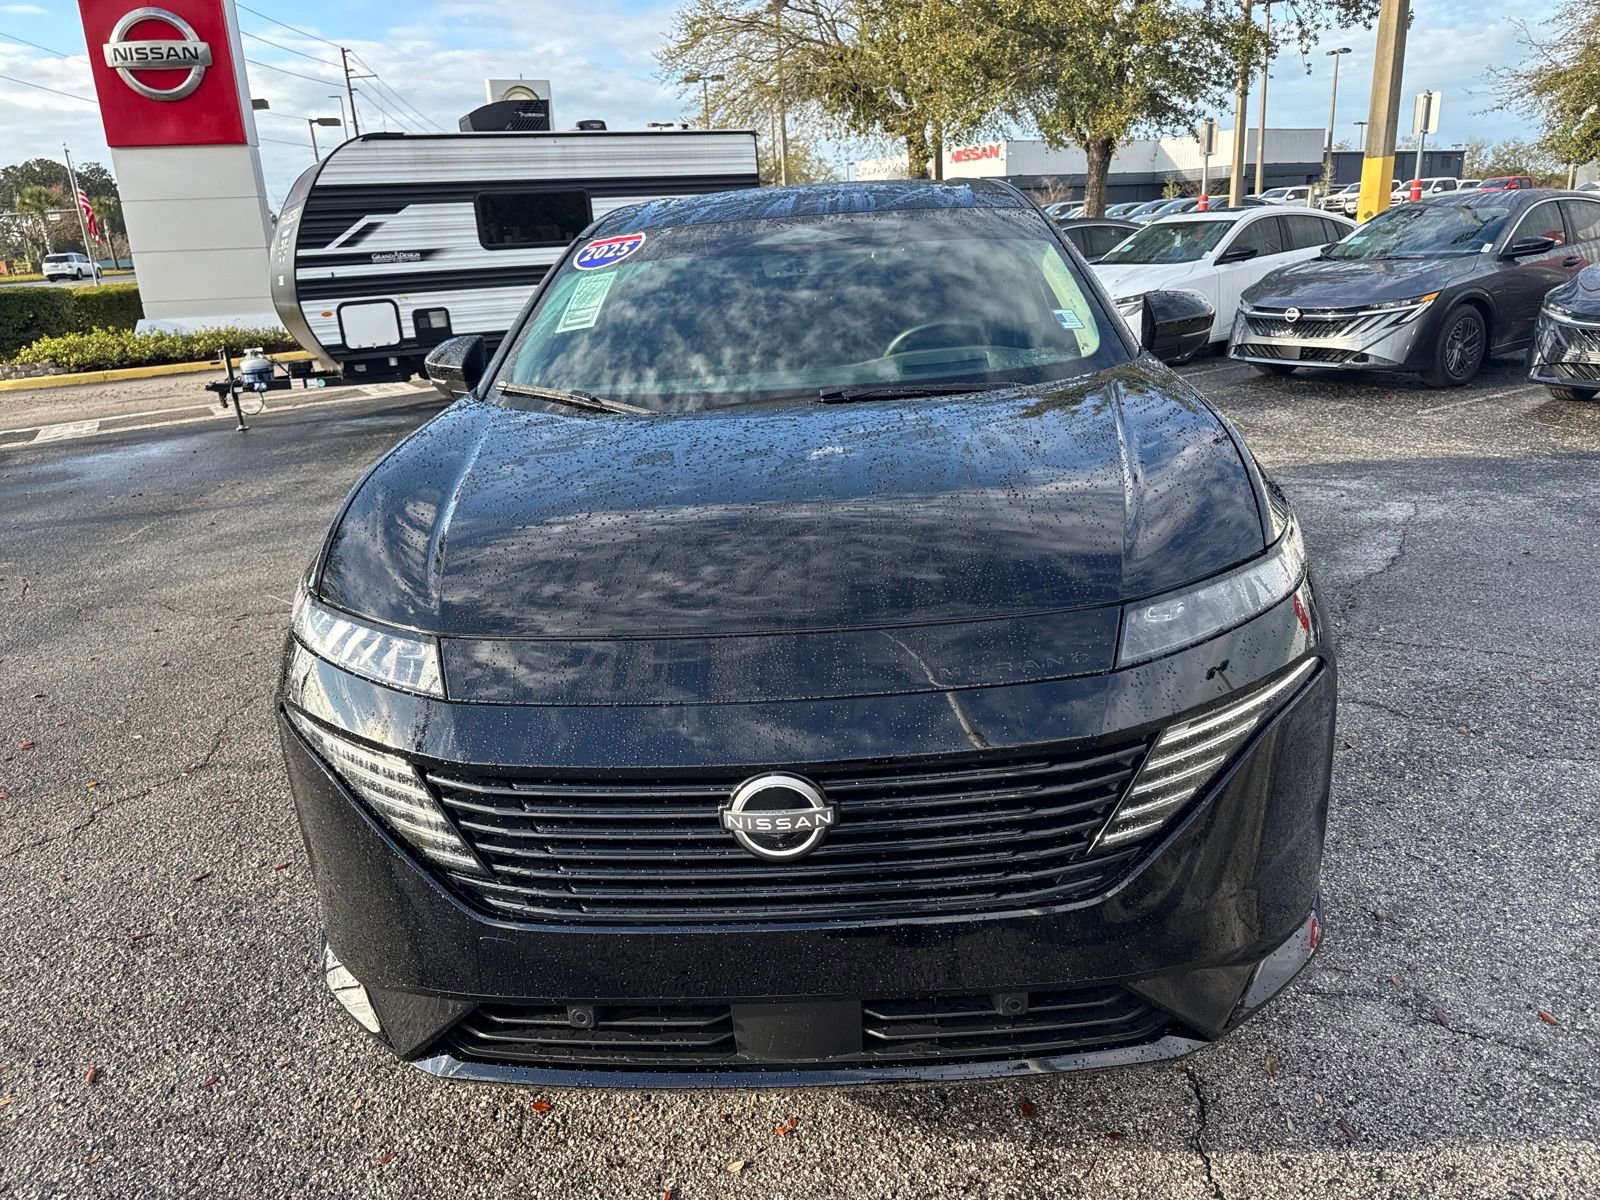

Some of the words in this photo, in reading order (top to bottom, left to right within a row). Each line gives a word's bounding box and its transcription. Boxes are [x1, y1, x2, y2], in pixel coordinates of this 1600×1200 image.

[112, 46, 200, 62] NISSAN
[951, 144, 1000, 164] NISSAN
[579, 241, 635, 263] 2025
[727, 811, 832, 830] NISSAN
